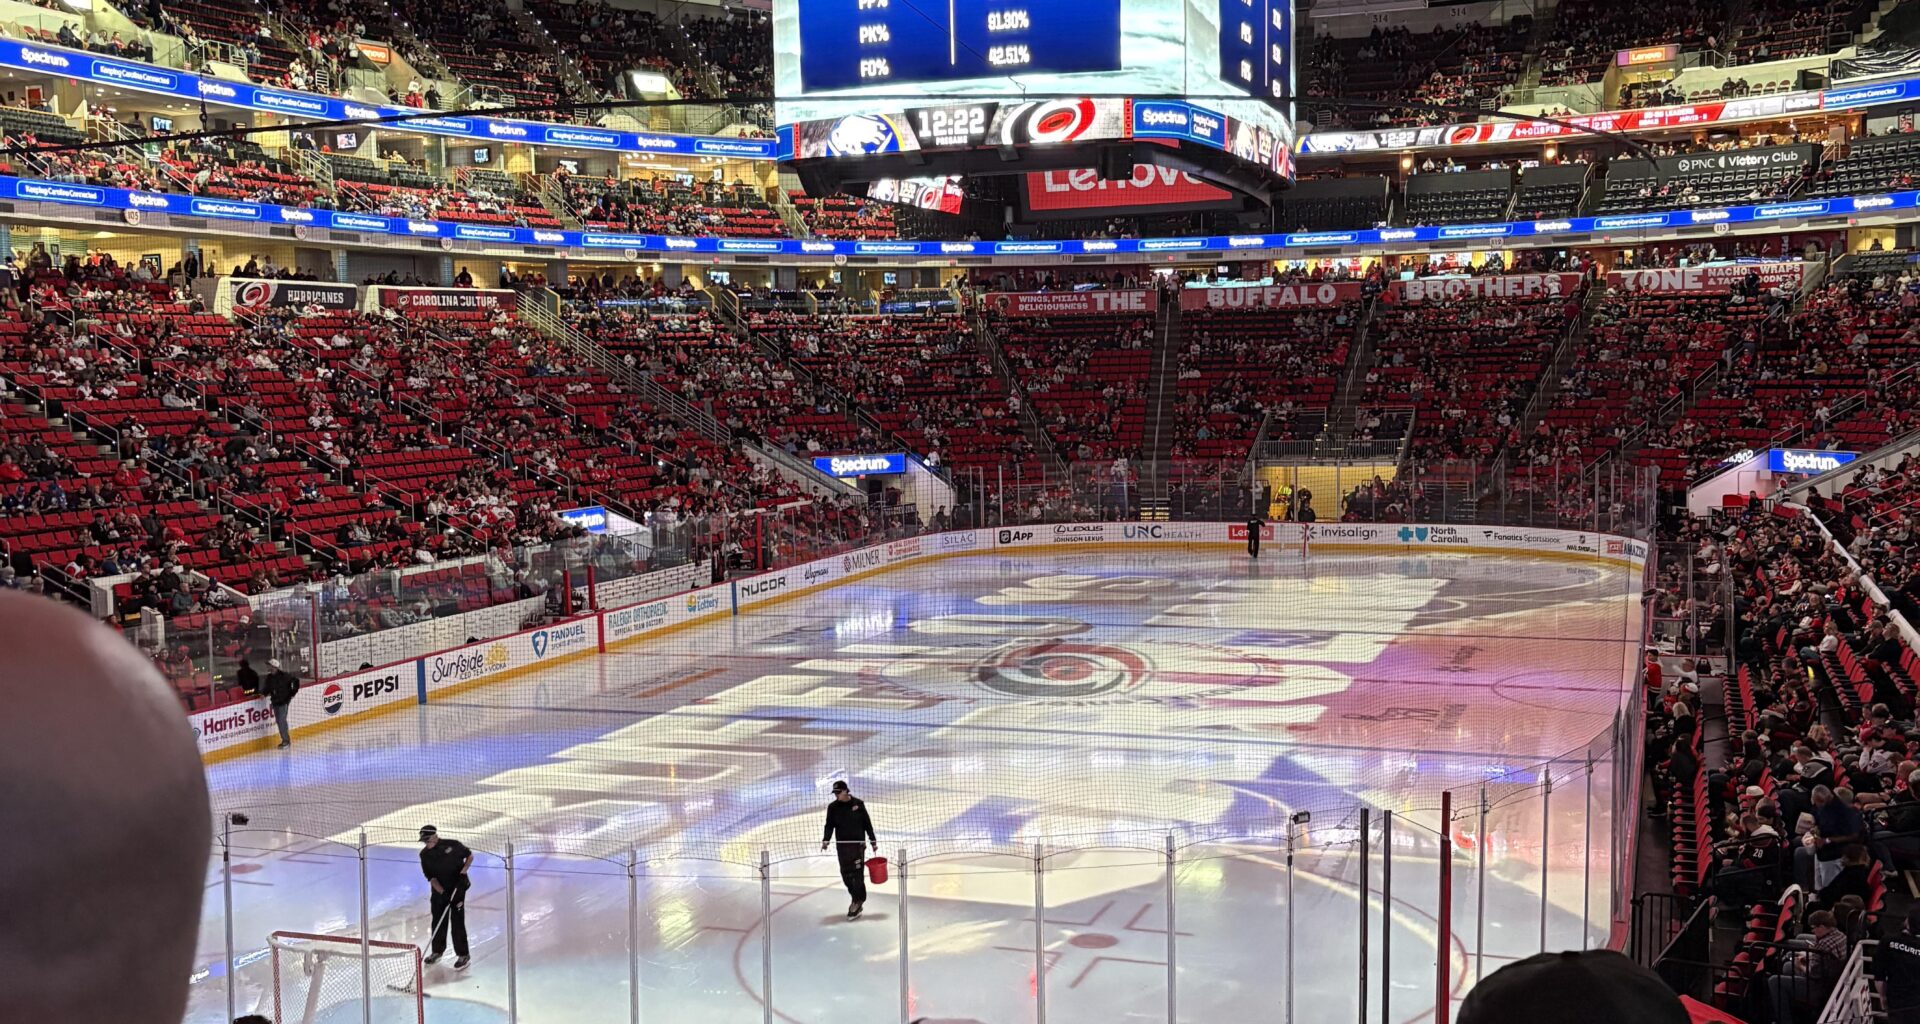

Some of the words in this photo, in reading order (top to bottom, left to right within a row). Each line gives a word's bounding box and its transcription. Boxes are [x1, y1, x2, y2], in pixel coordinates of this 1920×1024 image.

[860, 25, 889, 43] PK%
[22, 48, 67, 67] Spectrum
[363, 48, 386, 59] enovo
[1631, 52, 1662, 61] Lenovo
[860, 58, 889, 77] FO%
[100, 66, 121, 78] Keeping
[122, 70, 142, 80] Carolina
[143, 73, 170, 85] Connected
[198, 81, 234, 97] Spectrum
[1824, 95, 1845, 103] Keeping
[1845, 92, 1867, 100] Carolina
[1867, 87, 1896, 97] Connected
[345, 105, 378, 119] Spectrum
[1143, 109, 1187, 126] Spectrum
[490, 123, 524, 135] Spectrum
[918, 108, 985, 138] 12:22
[638, 137, 674, 148] Spectrum
[1691, 158, 1715, 170] PNC
[1728, 155, 1769, 167] Victory
[1772, 151, 1798, 162] Club
[130, 193, 167, 207] Spectrum
[1854, 197, 1892, 210] Spectrum
[281, 208, 311, 221] Spectrum
[1692, 211, 1728, 223] Spectrum
[408, 221, 436, 233] Spectrum
[1535, 222, 1570, 232] Spectrum
[1716, 224, 1727, 232] 113
[534, 231, 562, 242] Spectrum
[1229, 236, 1263, 246] Spectrum
[1380, 230, 1415, 240] Spectrum
[666, 238, 696, 249] Spectrum
[801, 243, 834, 252] Spectrum
[941, 243, 974, 252] Spectrum
[1083, 241, 1116, 251] Spectrum
[1760, 264, 1800, 274] WRAPS
[1620, 268, 1703, 291] ZONE
[1708, 277, 1716, 285] &
[1406, 274, 1562, 301] BROTHERS
[288, 290, 344, 304] HURRICANES
[413, 295, 459, 307] CAROLINA
[460, 295, 499, 307] CULTURE
[1018, 295, 1050, 303] WINGS,
[1052, 294, 1078, 302] PIZZA
[1091, 291, 1146, 311] THE
[1207, 283, 1336, 307] BUFFALO
[1018, 302, 1089, 311] DELICIOUSNESS
[830, 457, 888, 475] Spectrum
[1783, 450, 1836, 471] Spectrum
[1066, 524, 1103, 532] LEXUS
[1124, 525, 1162, 539] UNC
[1164, 531, 1201, 539] HEALTH
[1232, 527, 1270, 537] Lenvo
[1322, 526, 1377, 540] invisalign
[1431, 526, 1457, 535] North
[944, 533, 973, 545] SILAC
[1054, 535, 1083, 543] JOHNSON
[1084, 534, 1104, 542] LEXUS
[1431, 534, 1469, 543] Carolina
[1494, 532, 1522, 541] Fanatics
[1524, 533, 1560, 544] Sportsbook
[851, 549, 880, 570] MILNER
[741, 576, 786, 598] NUCOR
[697, 597, 719, 611] Lottery
[608, 610, 632, 628] RALEIGH
[551, 624, 585, 641] FANDUEL
[432, 649, 484, 683] Surfside
[460, 671, 472, 680] ICED
[473, 668, 484, 677] TEA
[489, 662, 507, 672] VODKA
[353, 674, 399, 702] PEPSI
[323, 693, 343, 705] PEPSI
[204, 712, 245, 736] Harris
[1889, 941, 1920, 956] SECURIT
